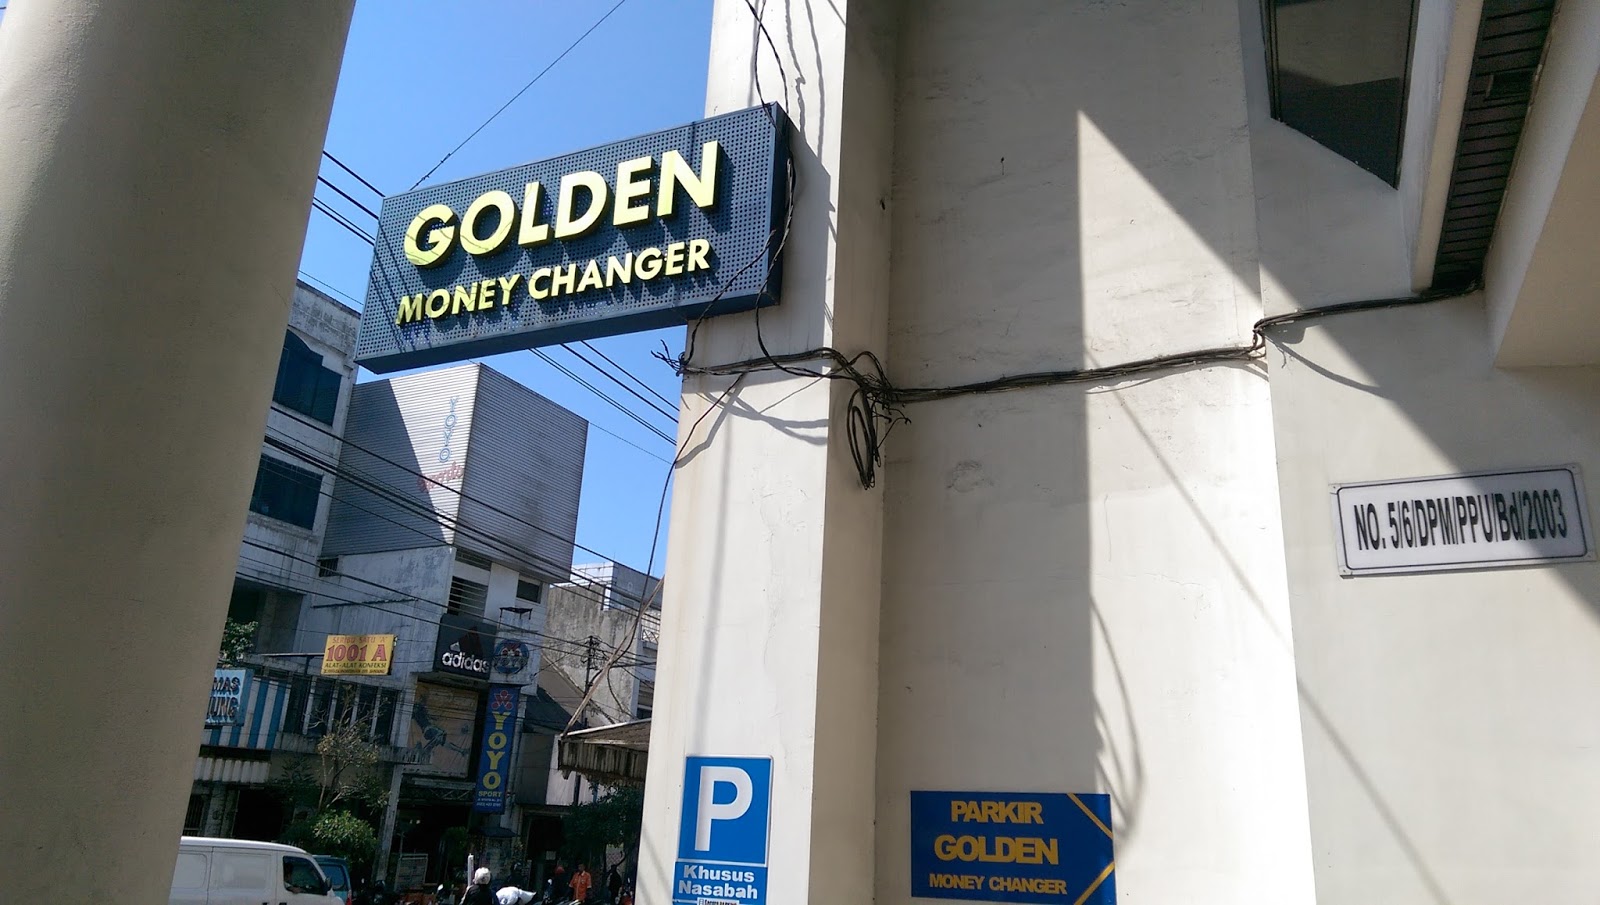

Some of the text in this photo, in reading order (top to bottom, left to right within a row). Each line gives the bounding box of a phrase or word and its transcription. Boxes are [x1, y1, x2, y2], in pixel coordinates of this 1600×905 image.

[403, 140, 723, 268] GOLDEN
[395, 238, 711, 326] MONEY CHANGER
[1353, 502, 1386, 551] NO.
[326, 644, 387, 662] 1001 A
[441, 651, 490, 673] adidas
[359, 661, 387, 669] KONFEKSI
[482, 711, 511, 790] YOYO
[478, 790, 502, 798] SPORT
[694, 765, 753, 852] P
[951, 800, 1044, 825] PARKIR
[934, 834, 1059, 865] GOLDEN
[683, 864, 755, 883] Khusus
[929, 873, 1068, 895] MONEY CHANGER
[678, 880, 758, 899] Nasabah
